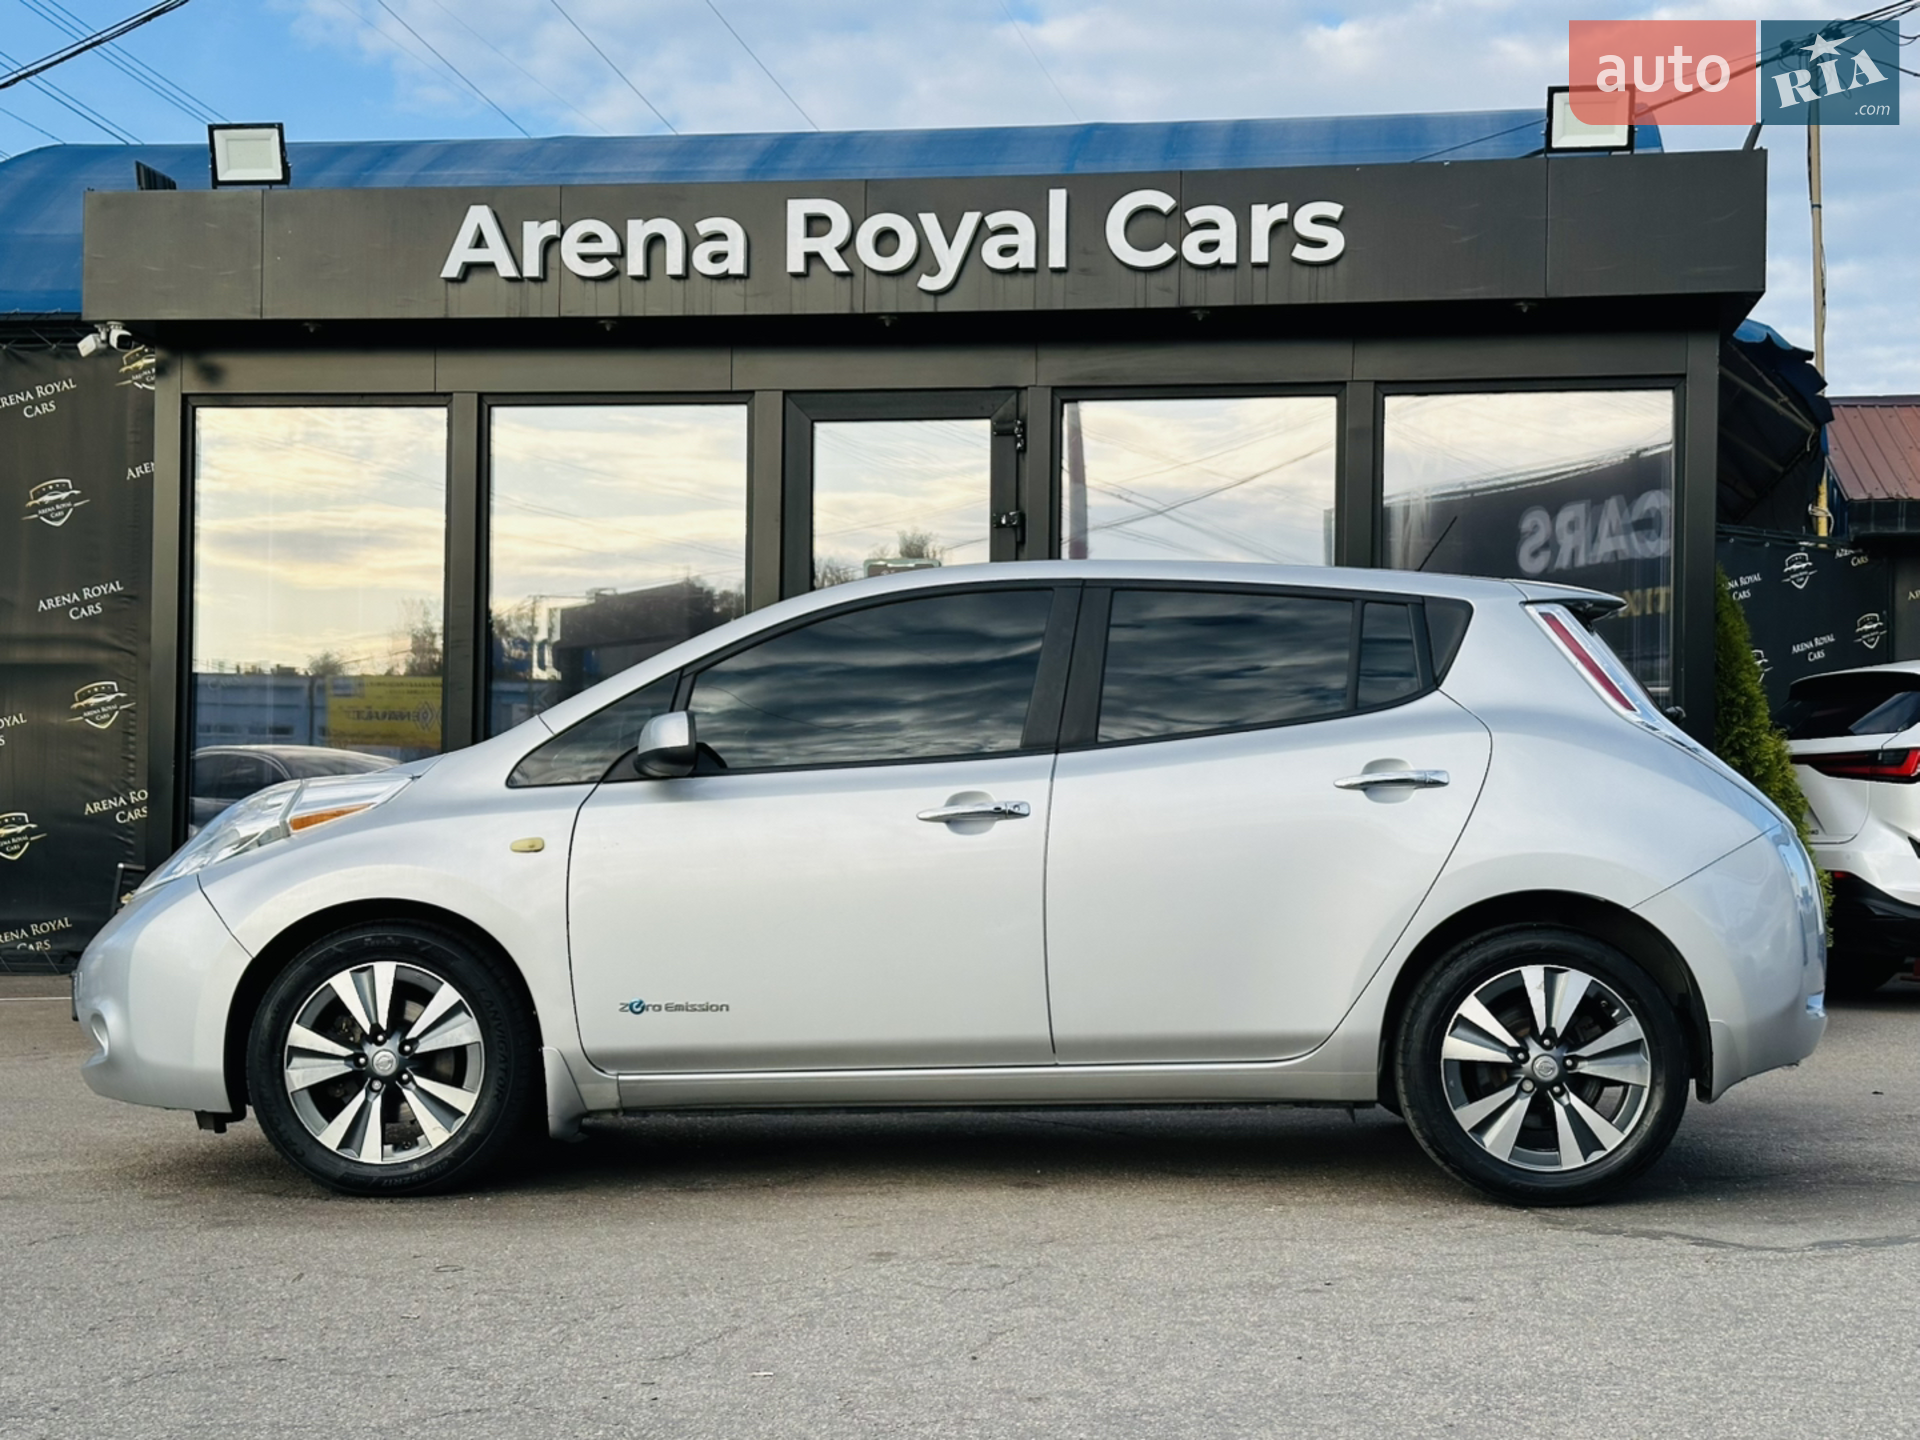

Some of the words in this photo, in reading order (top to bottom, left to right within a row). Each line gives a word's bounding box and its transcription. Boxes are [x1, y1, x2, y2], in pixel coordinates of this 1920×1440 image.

[439, 204, 748, 280] Arena
[786, 188, 1068, 293] Royal
[1105, 189, 1346, 270] Cars
[0, 390, 34, 408] RENA
[35, 378, 77, 398] ROYAL
[23, 400, 56, 418] CARS
[38, 592, 81, 612] ARENA
[82, 580, 124, 600] ROYAL
[69, 602, 102, 620] CARS
[1807, 649, 1825, 662] CARS
[84, 796, 127, 815] ARENA
[115, 806, 148, 824] CARS
[30, 917, 73, 936] ROYAL
[664, 1002, 730, 1013] Emission
